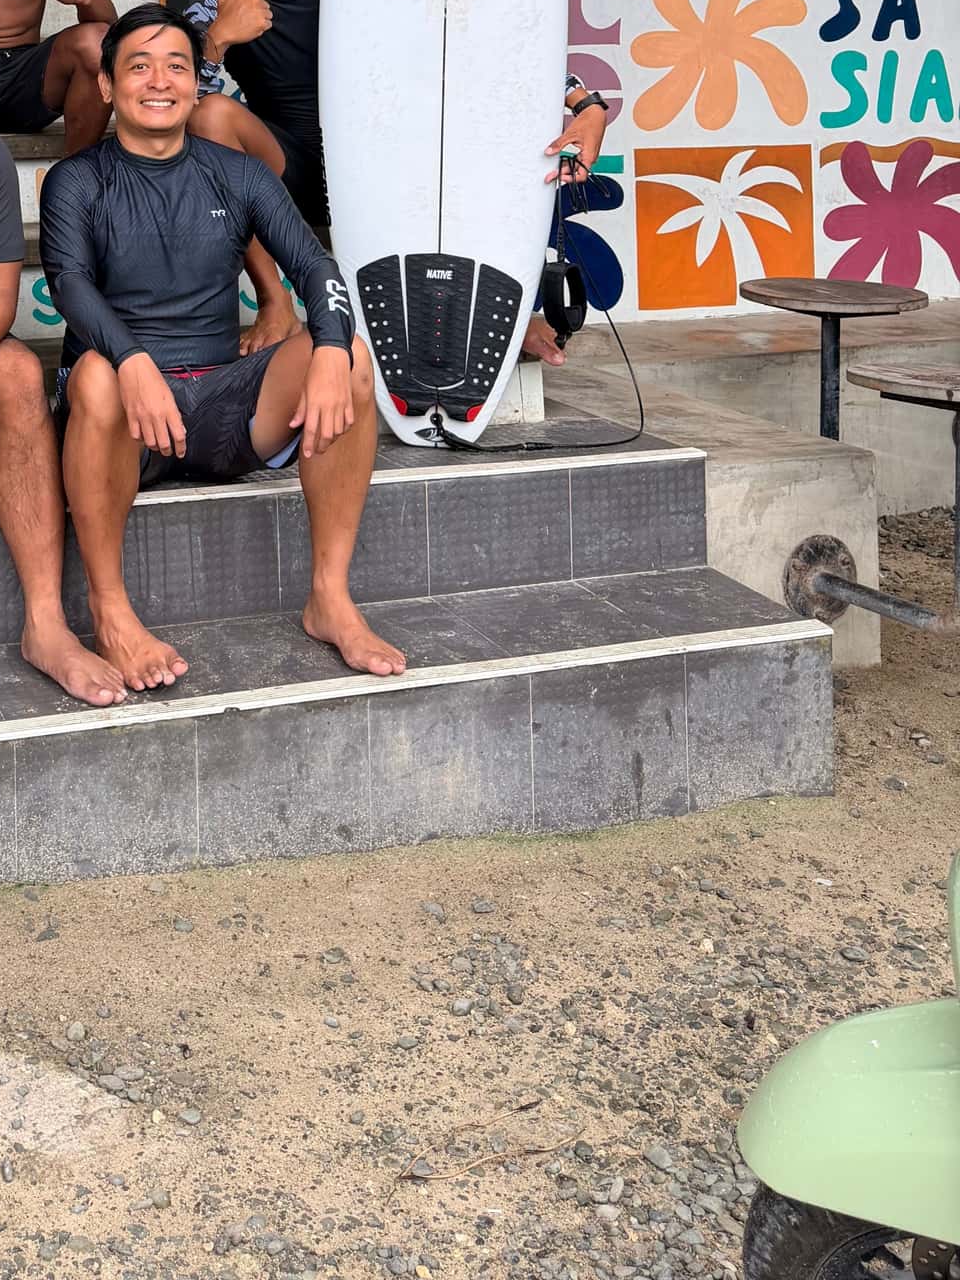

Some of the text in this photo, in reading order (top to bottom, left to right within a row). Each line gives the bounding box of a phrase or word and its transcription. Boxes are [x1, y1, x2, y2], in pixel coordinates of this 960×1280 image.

[818, 49, 960, 129] SIA
[210, 209, 226, 218] TYR
[426, 268, 453, 280] NATIVE
